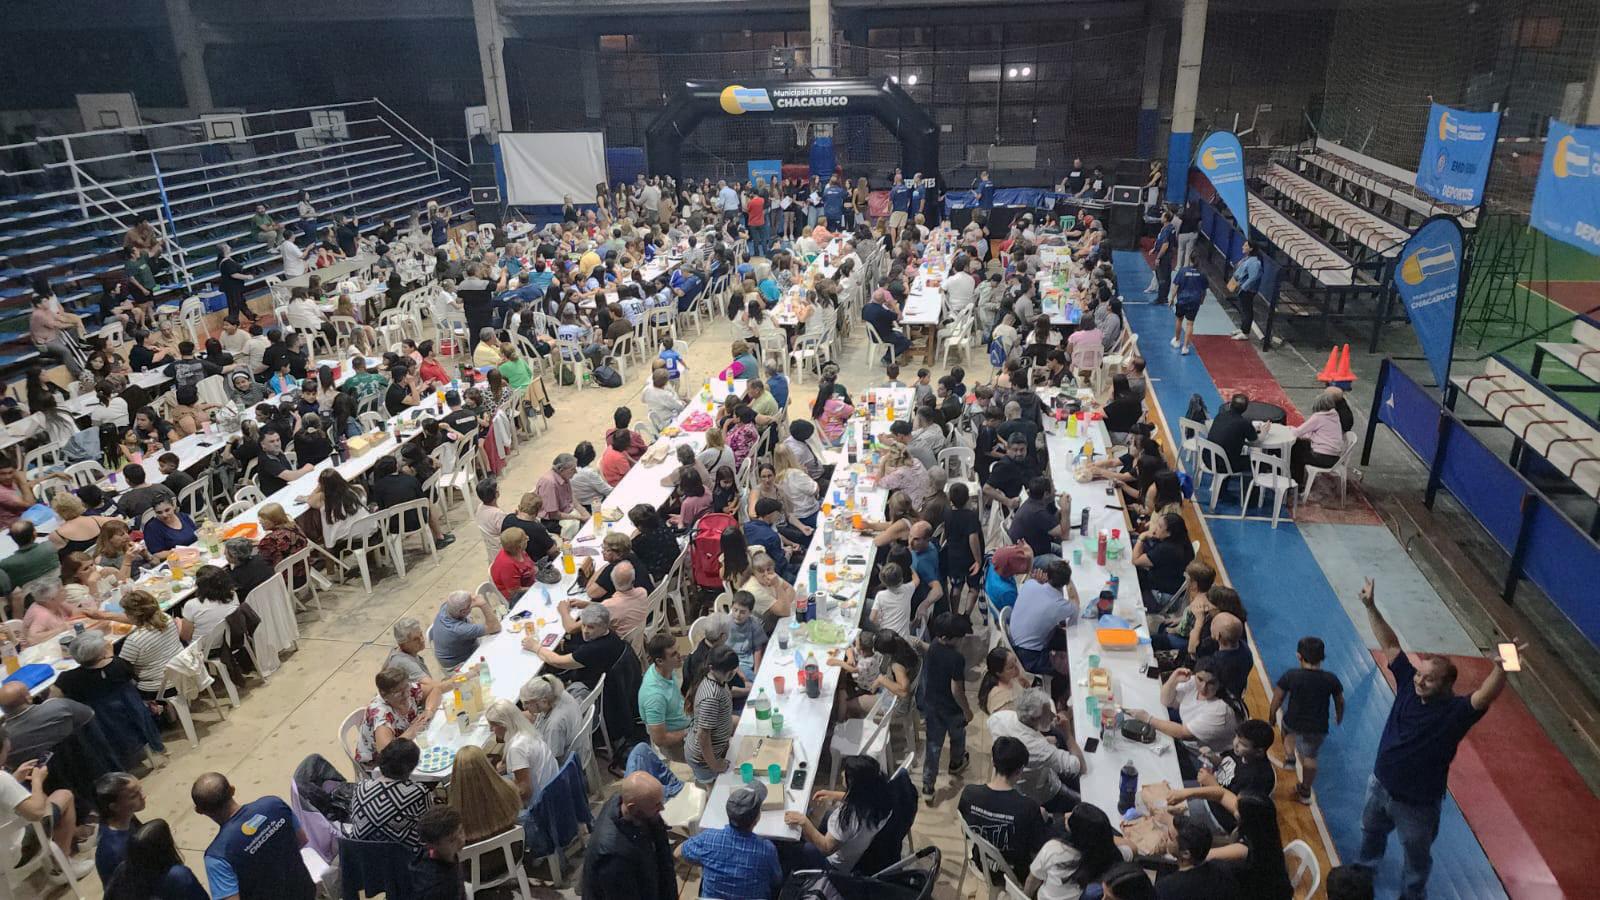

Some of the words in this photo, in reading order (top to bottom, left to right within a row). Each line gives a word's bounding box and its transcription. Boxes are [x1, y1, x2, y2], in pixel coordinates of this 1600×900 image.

[774, 88, 821, 97] Municipalidad
[777, 96, 848, 108] CHACABUCO
[1410, 290, 1457, 309] CHACABUCO
[249, 818, 286, 854] CHACABUCO
